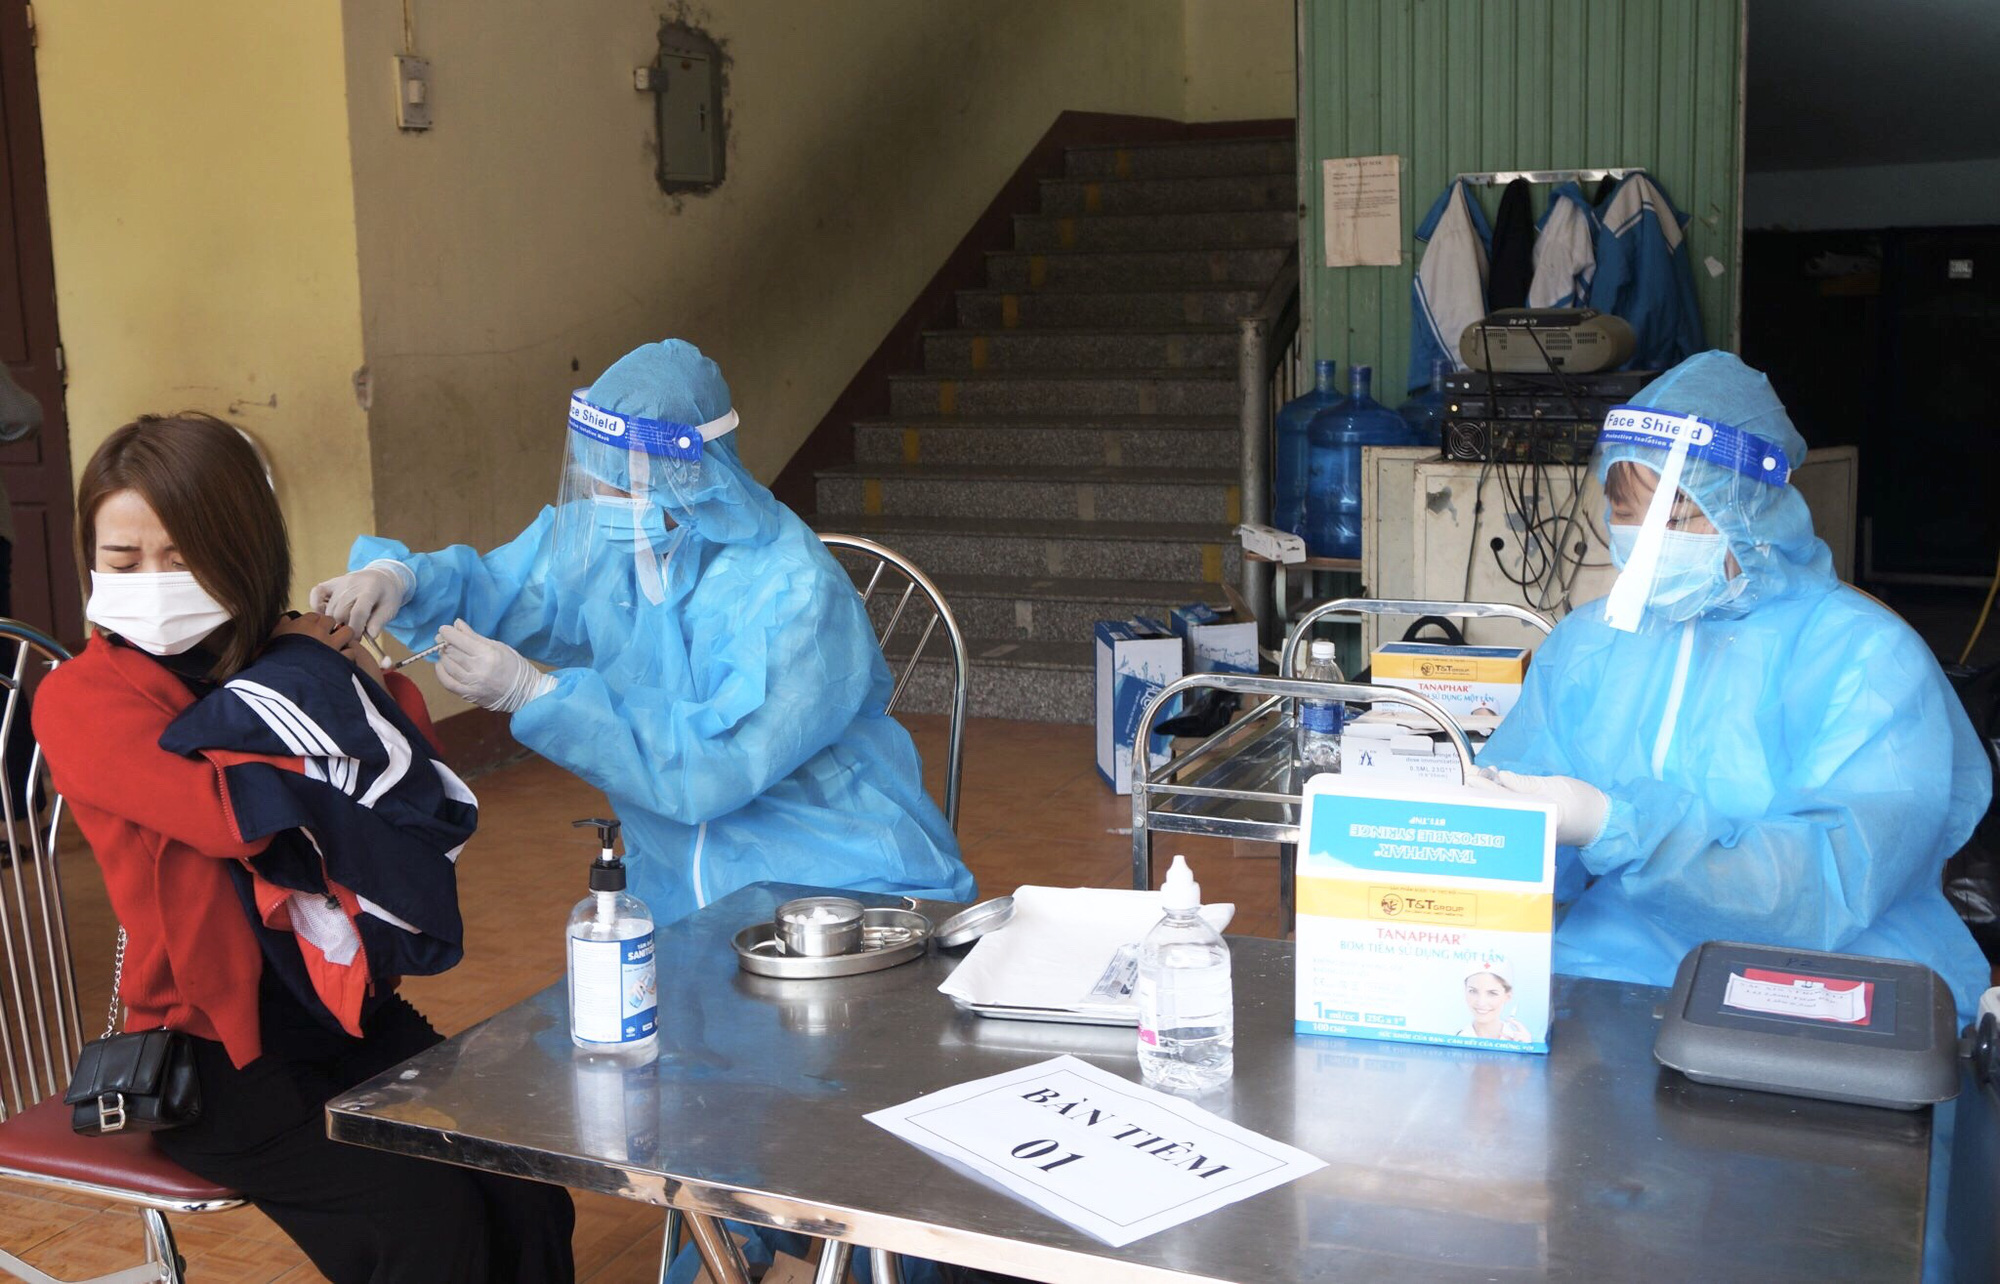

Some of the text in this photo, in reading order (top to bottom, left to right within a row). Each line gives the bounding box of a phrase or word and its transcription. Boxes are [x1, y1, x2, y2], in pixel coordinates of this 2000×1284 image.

[582, 409, 617, 432] Shield
[1607, 414, 1635, 427] Face
[1634, 436, 1667, 447] Isolation
[1418, 683, 1469, 693] TANAPHAR
[1349, 823, 1505, 848] DISPOSABLE SYRINGE
[1313, 1001, 1324, 1018] 1
[1020, 1087, 1232, 1180] BÀN TIÊM
[1010, 1138, 1086, 1174] 01
